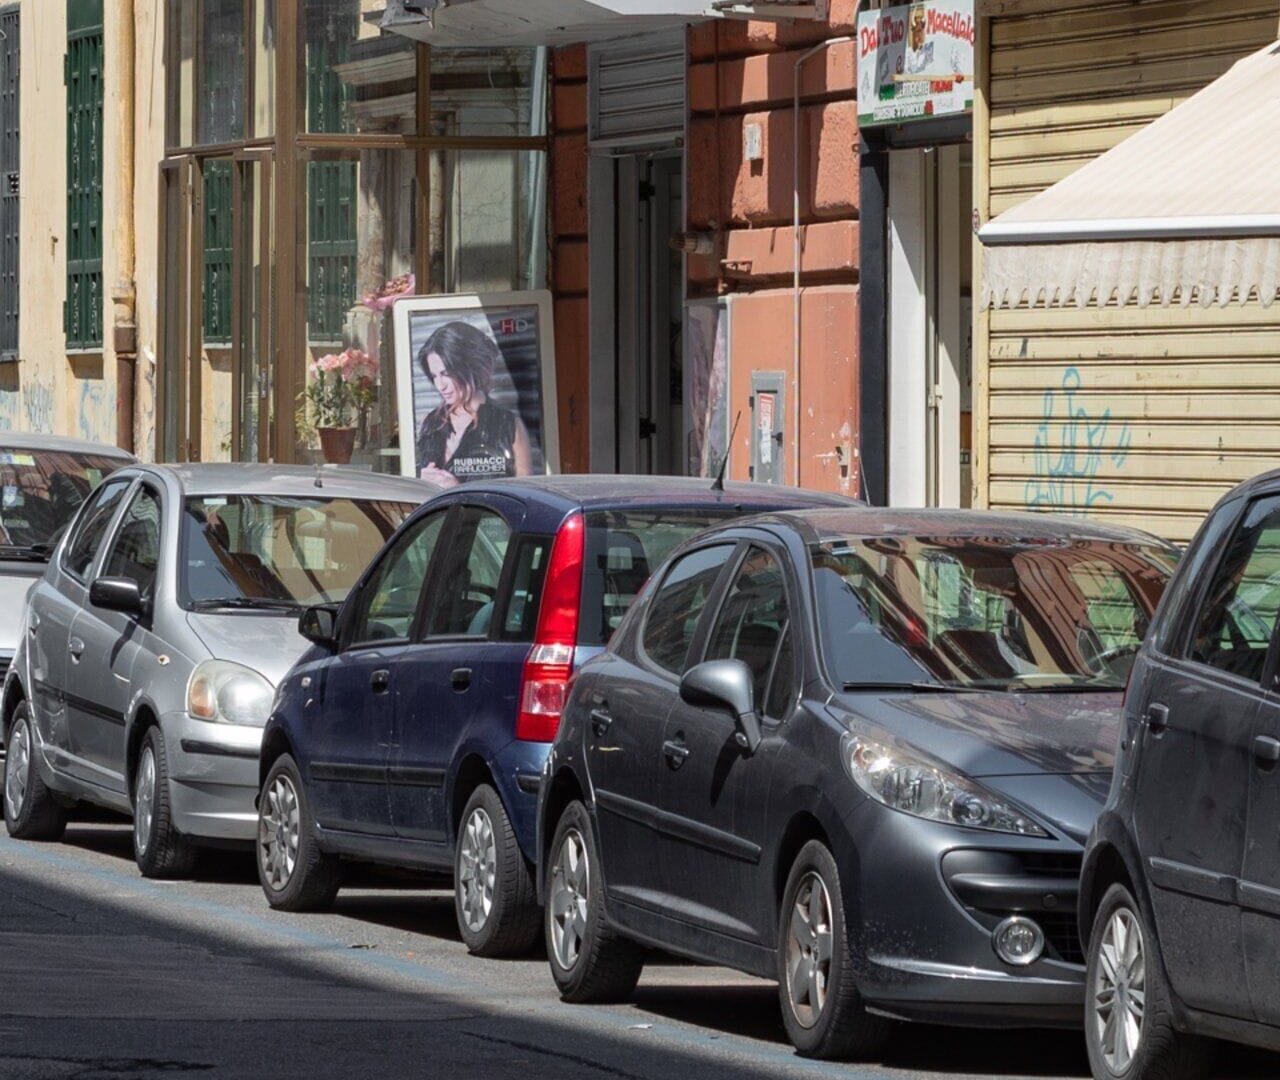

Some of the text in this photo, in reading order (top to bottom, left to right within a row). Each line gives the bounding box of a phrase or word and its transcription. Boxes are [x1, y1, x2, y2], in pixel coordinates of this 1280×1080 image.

[861, 19, 880, 57] Dal
[883, 15, 904, 46] Tuo
[454, 456, 506, 466] RUBINACCI
